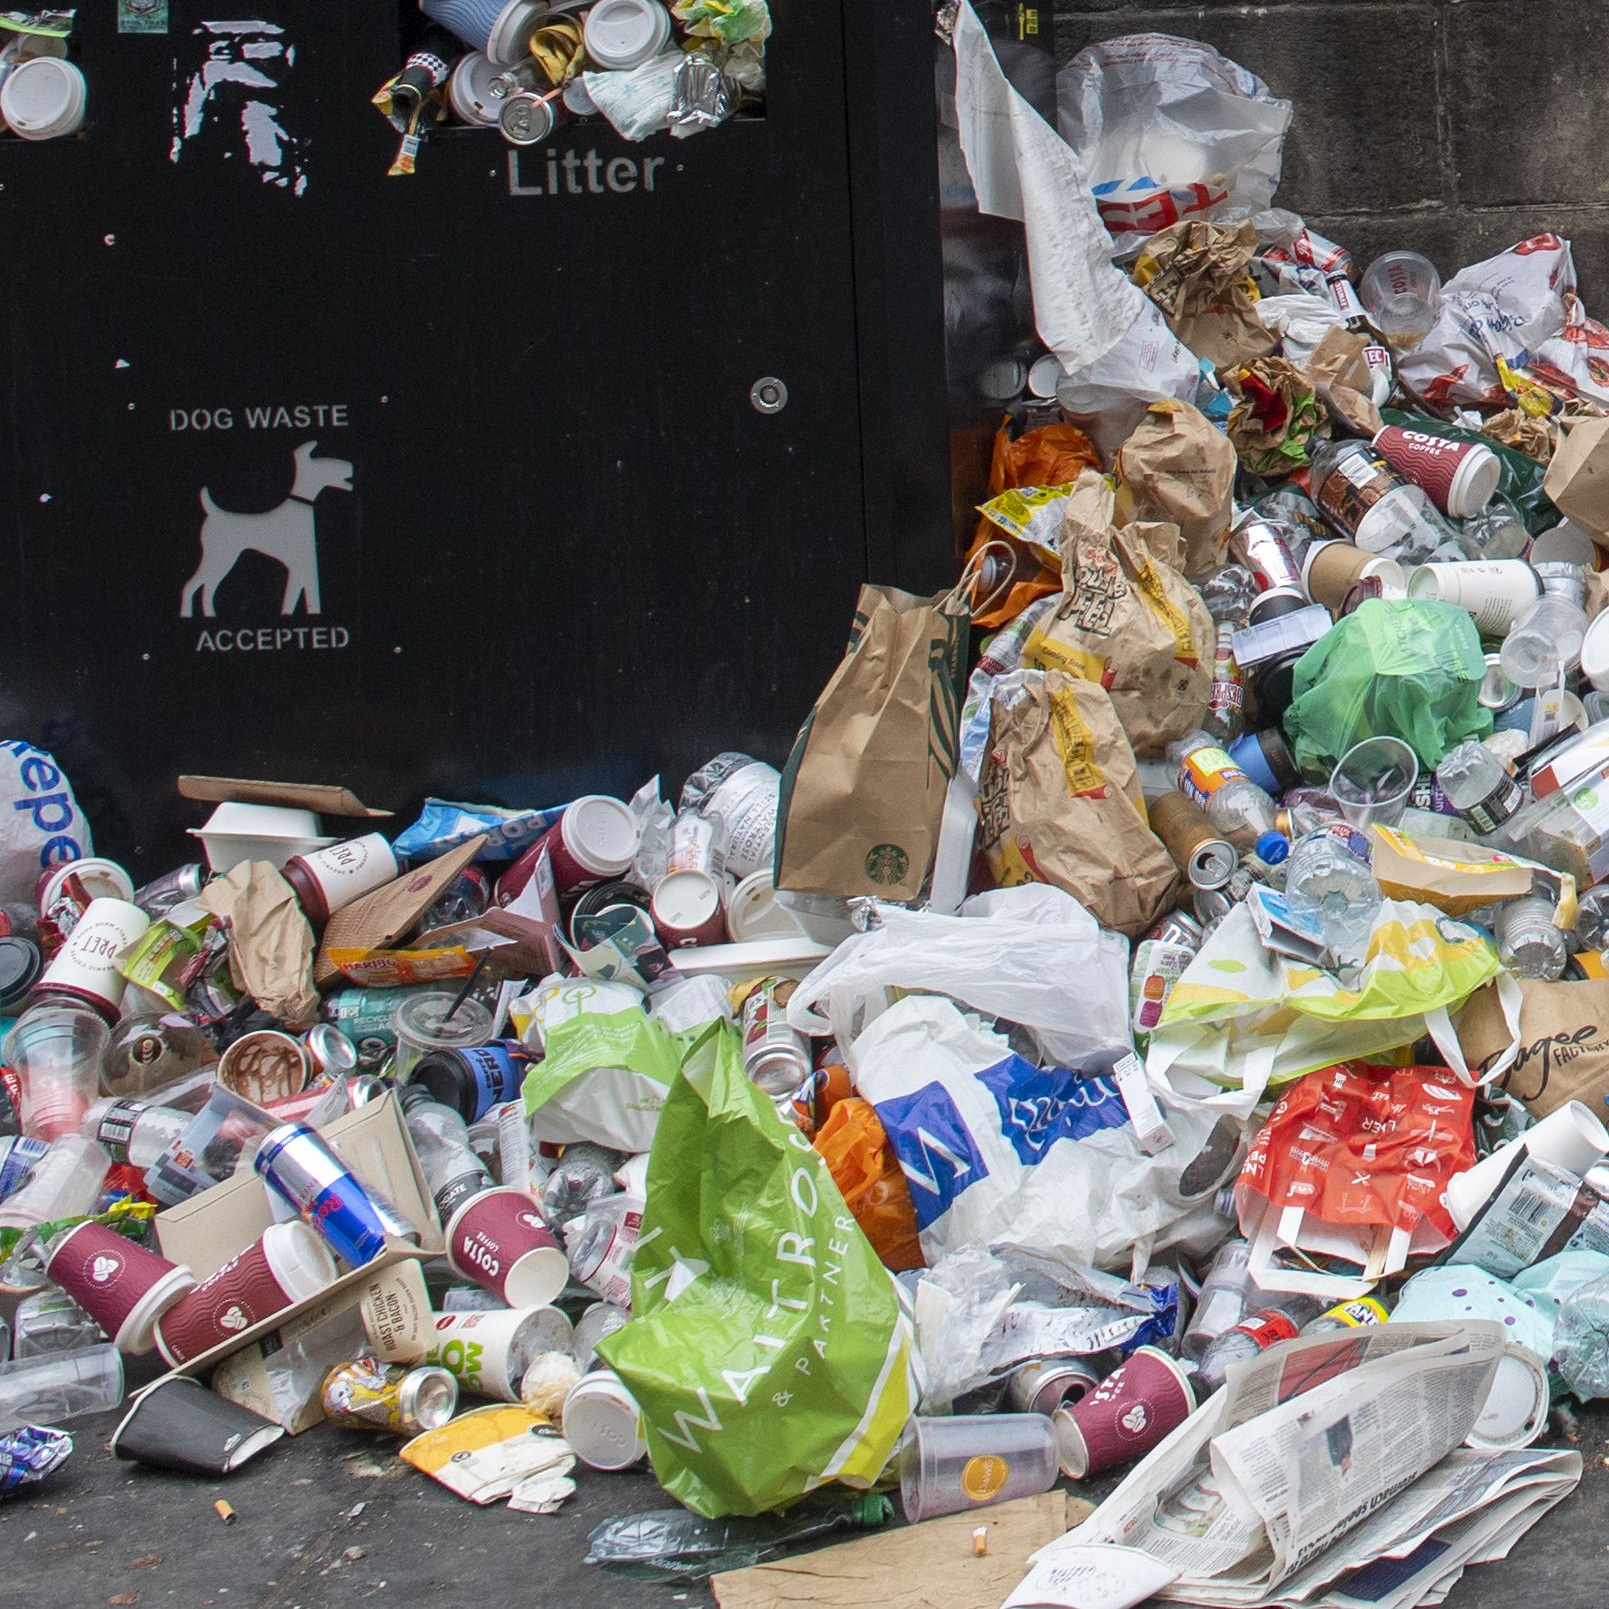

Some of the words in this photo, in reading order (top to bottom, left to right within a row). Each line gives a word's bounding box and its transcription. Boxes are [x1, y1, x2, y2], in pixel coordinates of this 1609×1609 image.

[508, 148, 665, 197] Litter
[1387, 265, 1403, 295] COSTA
[170, 406, 234, 432] DOG
[245, 404, 349, 430] WASTE
[1401, 429, 1461, 453] COSTA
[1408, 441, 1442, 457] COFFEE
[196, 626, 349, 652] ACCEPTED
[78, 934, 118, 961] PRET
[462, 1235, 499, 1277] COSTA
[476, 1230, 500, 1253] COFFEE
[371, 1280, 391, 1323] CHICKEN
[385, 1290, 402, 1328] BACON
[771, 1390, 793, 1408] &
[794, 1213, 855, 1377] PARTNER
[383, 1320, 400, 1353] ROAST
